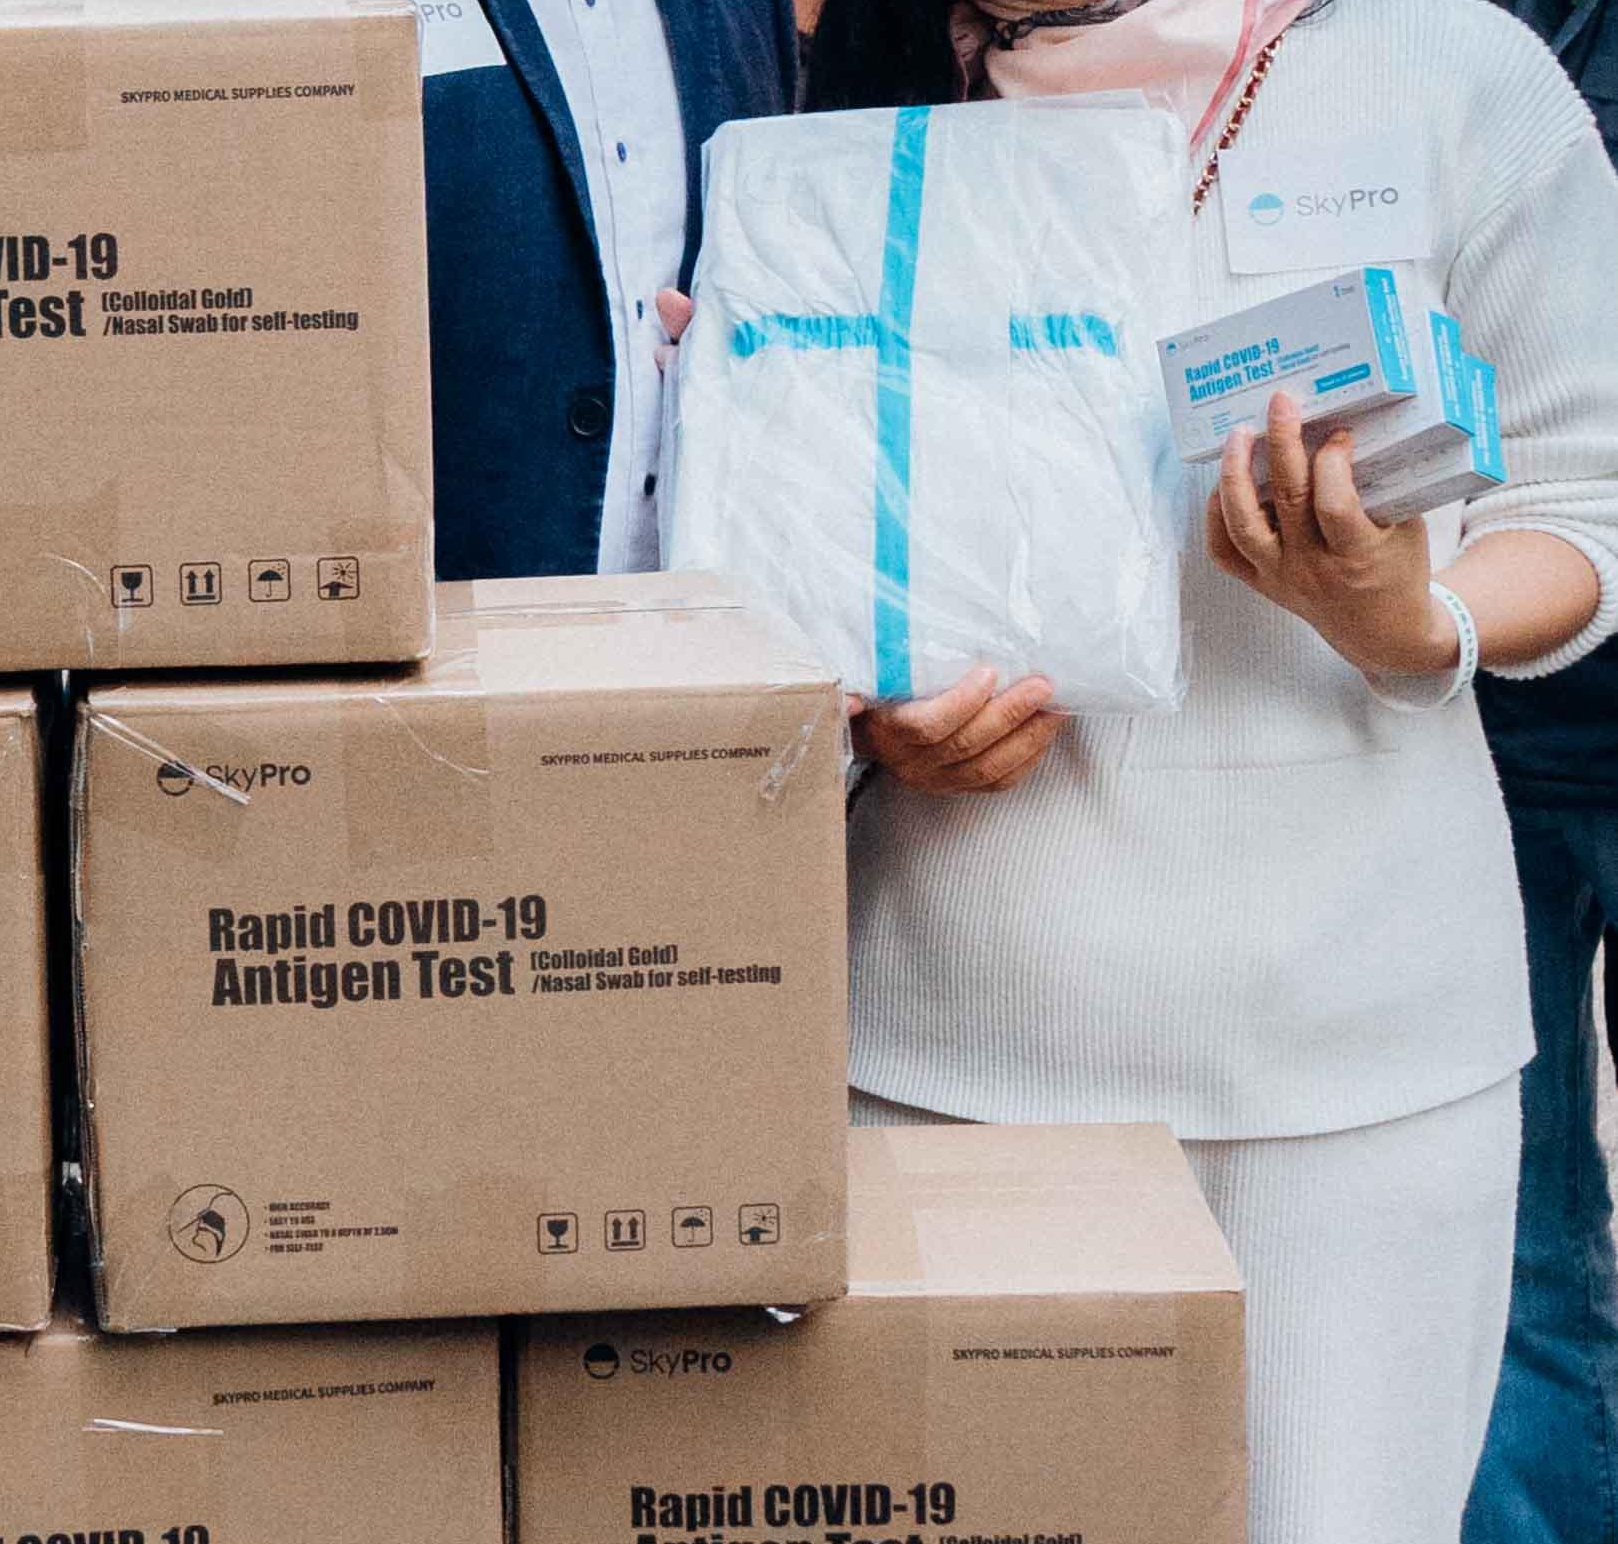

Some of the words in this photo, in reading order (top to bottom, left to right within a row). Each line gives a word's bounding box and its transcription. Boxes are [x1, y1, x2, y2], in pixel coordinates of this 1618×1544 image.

[420, 2, 463, 23] Pro
[121, 90, 169, 103] SKYPRO
[174, 87, 228, 101] MEDICAL
[232, 85, 291, 100] SUPPLIES
[294, 84, 355, 97] COMPANY
[1296, 187, 1399, 218] SkyPro
[166, 313, 218, 334] Swab
[222, 314, 246, 333] for
[1185, 359, 1221, 384] Rapid
[1223, 337, 1279, 370] COVID-19
[1190, 372, 1242, 402] Antigen
[1243, 359, 1275, 382] Test
[541, 753, 589, 767] SKYPRO
[593, 750, 646, 764] MEDICAL
[649, 747, 708, 762] SUPPLIES
[710, 745, 770, 759] COMPANY
[206, 763, 312, 793] SkyPro
[210, 904, 335, 955] Rapid
[348, 895, 547, 947] COVID-19
[210, 956, 400, 1009] Antigen
[412, 950, 515, 998] Test
[593, 970, 645, 991] Swab
[648, 970, 672, 989] for
[629, 1350, 731, 1378] SkyPro
[631, 1486, 752, 1532] Rapid
[764, 1483, 957, 1527] COVID-19
